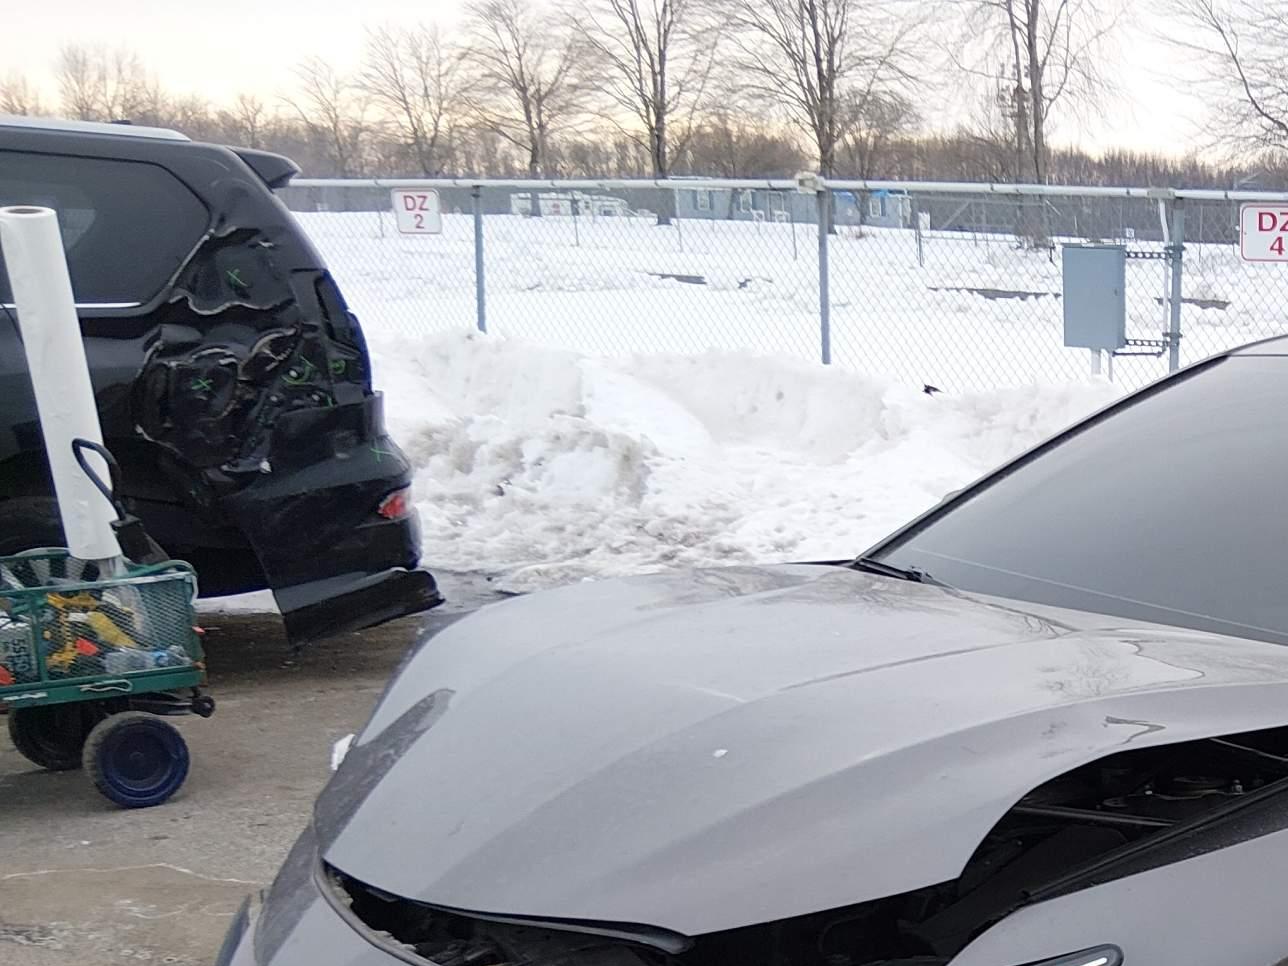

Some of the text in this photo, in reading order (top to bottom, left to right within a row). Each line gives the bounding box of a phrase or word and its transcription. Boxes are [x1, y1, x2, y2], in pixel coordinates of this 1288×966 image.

[403, 195, 429, 211] DZ
[414, 213, 425, 229] 2
[1269, 236, 1285, 256] 4
